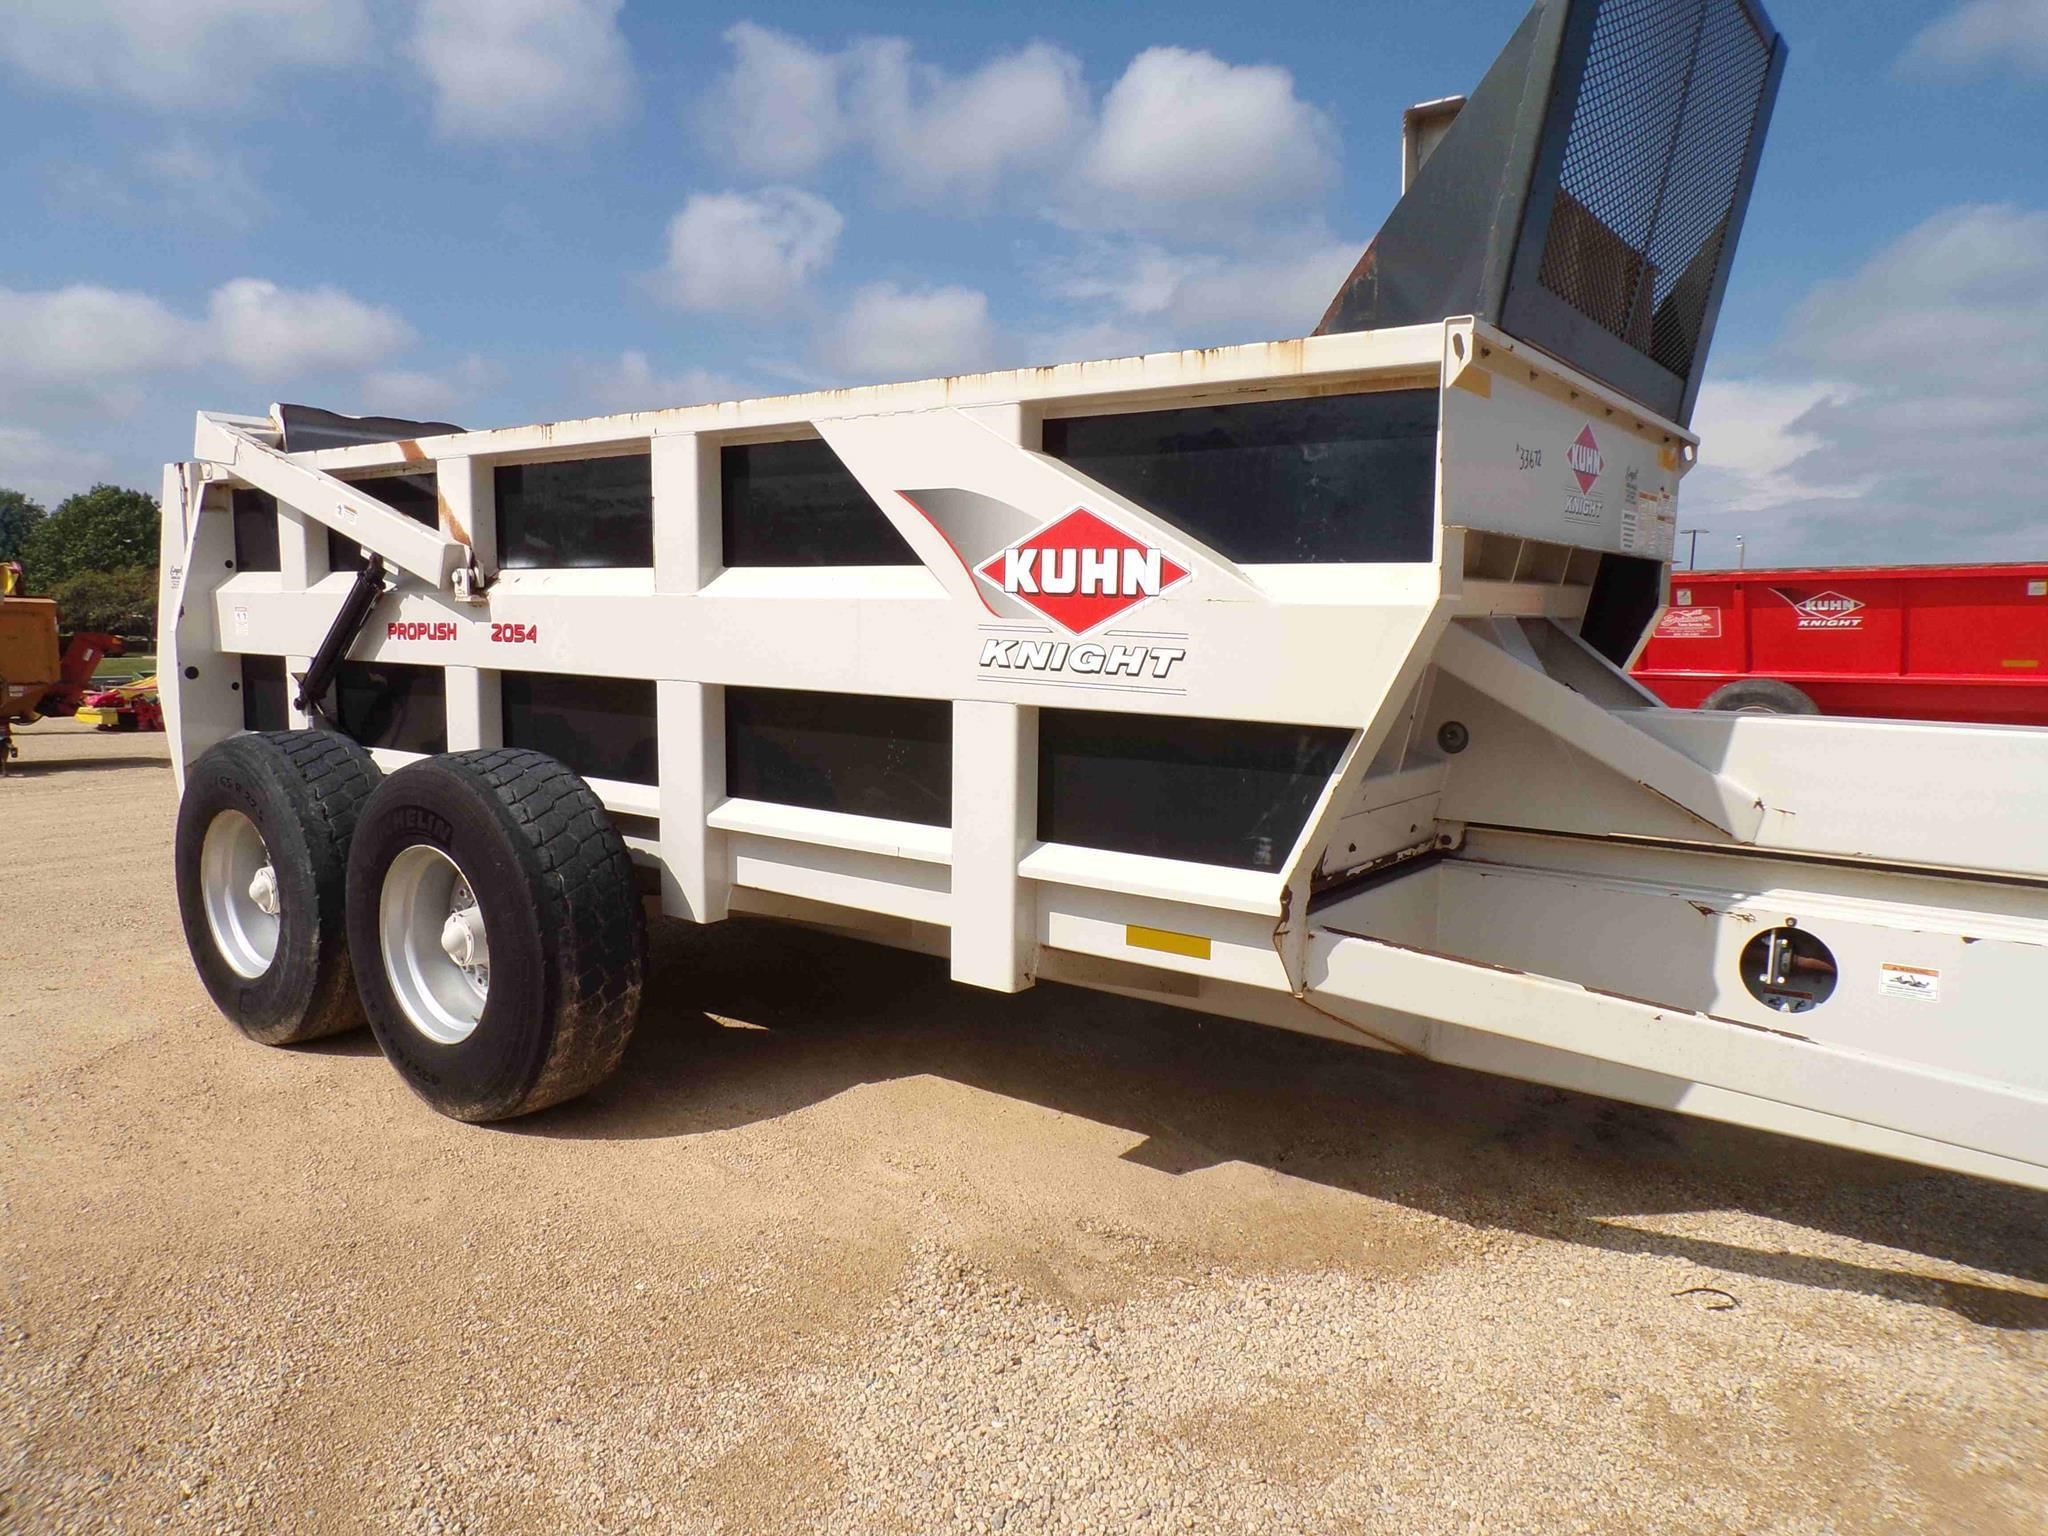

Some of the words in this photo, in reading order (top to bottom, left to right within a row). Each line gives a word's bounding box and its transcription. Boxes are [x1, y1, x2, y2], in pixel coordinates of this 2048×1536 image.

[1571, 444, 1601, 476] KUHN
[1564, 495, 1603, 518] KNIGHT
[1003, 548, 1161, 597] KUHN
[1805, 599, 1855, 611] KUHN
[388, 622, 457, 641] PROPUSH
[491, 623, 537, 643] 2054
[1798, 619, 1863, 627] KNIGHT
[979, 639, 1187, 679] KNIGHT
